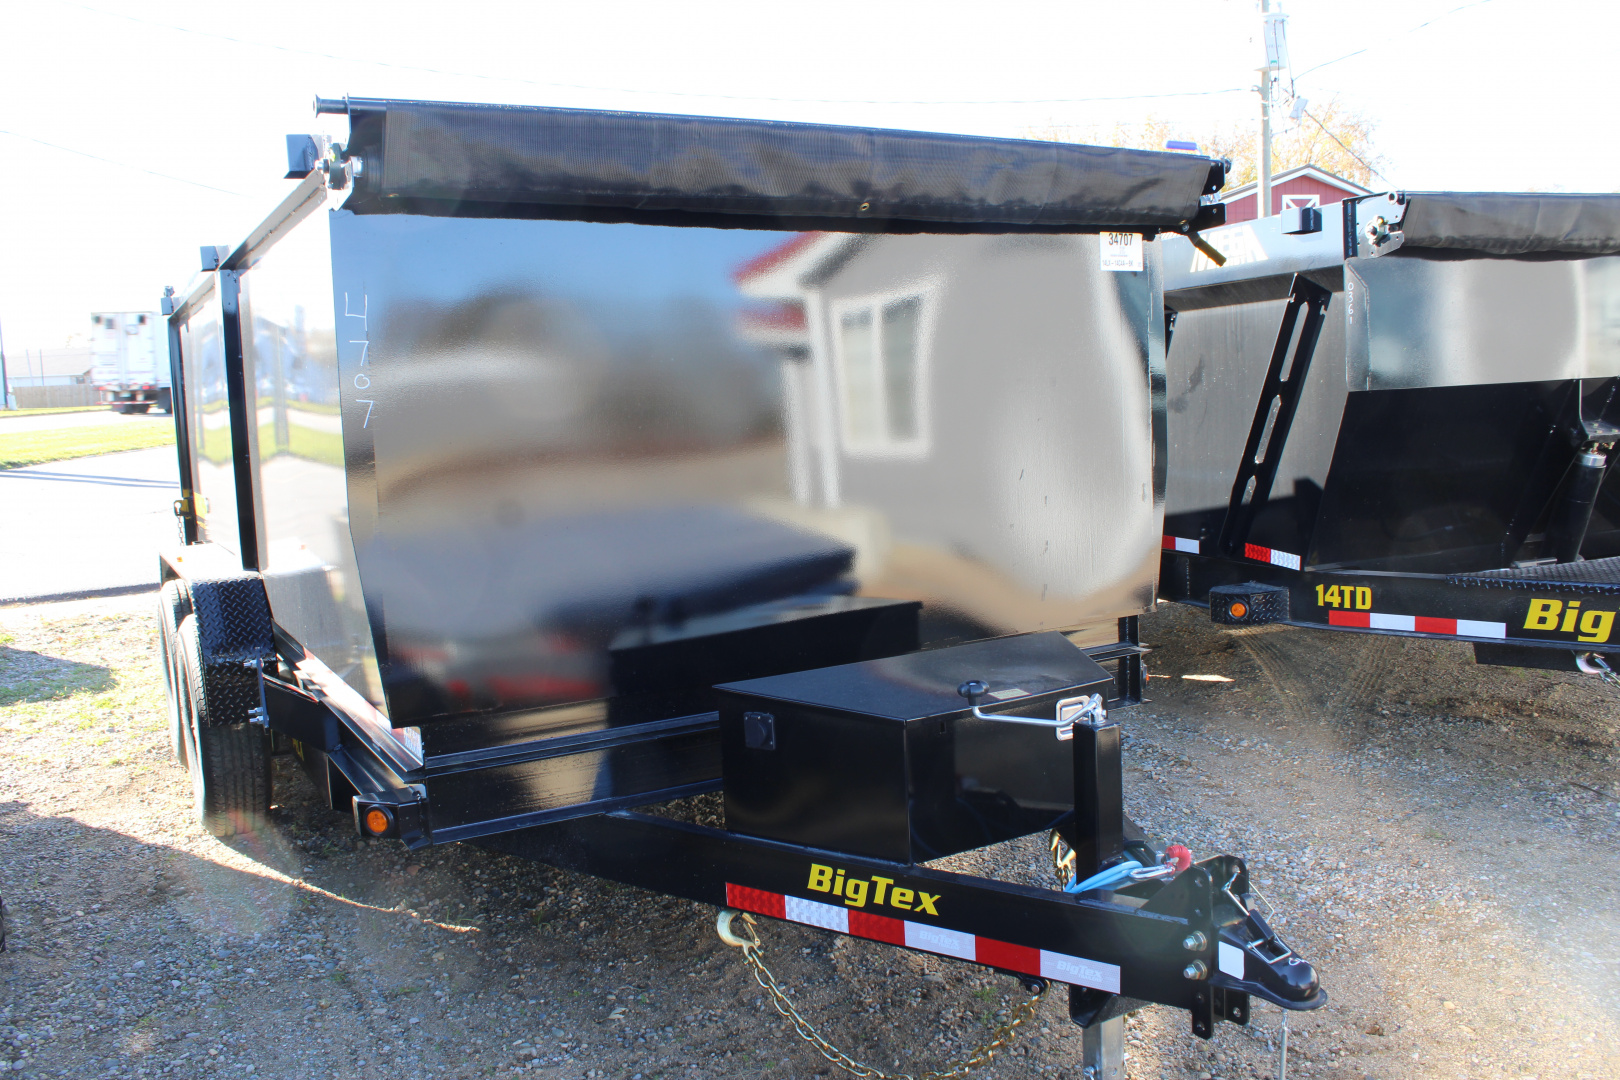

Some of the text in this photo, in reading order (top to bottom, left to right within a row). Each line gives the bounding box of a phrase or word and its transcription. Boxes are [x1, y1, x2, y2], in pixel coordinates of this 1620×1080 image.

[1108, 232, 1134, 246] 34707
[344, 291, 374, 429] 4707
[1315, 583, 1372, 610] 14TD
[1523, 598, 1620, 643] Big
[807, 863, 942, 917] BigTex
